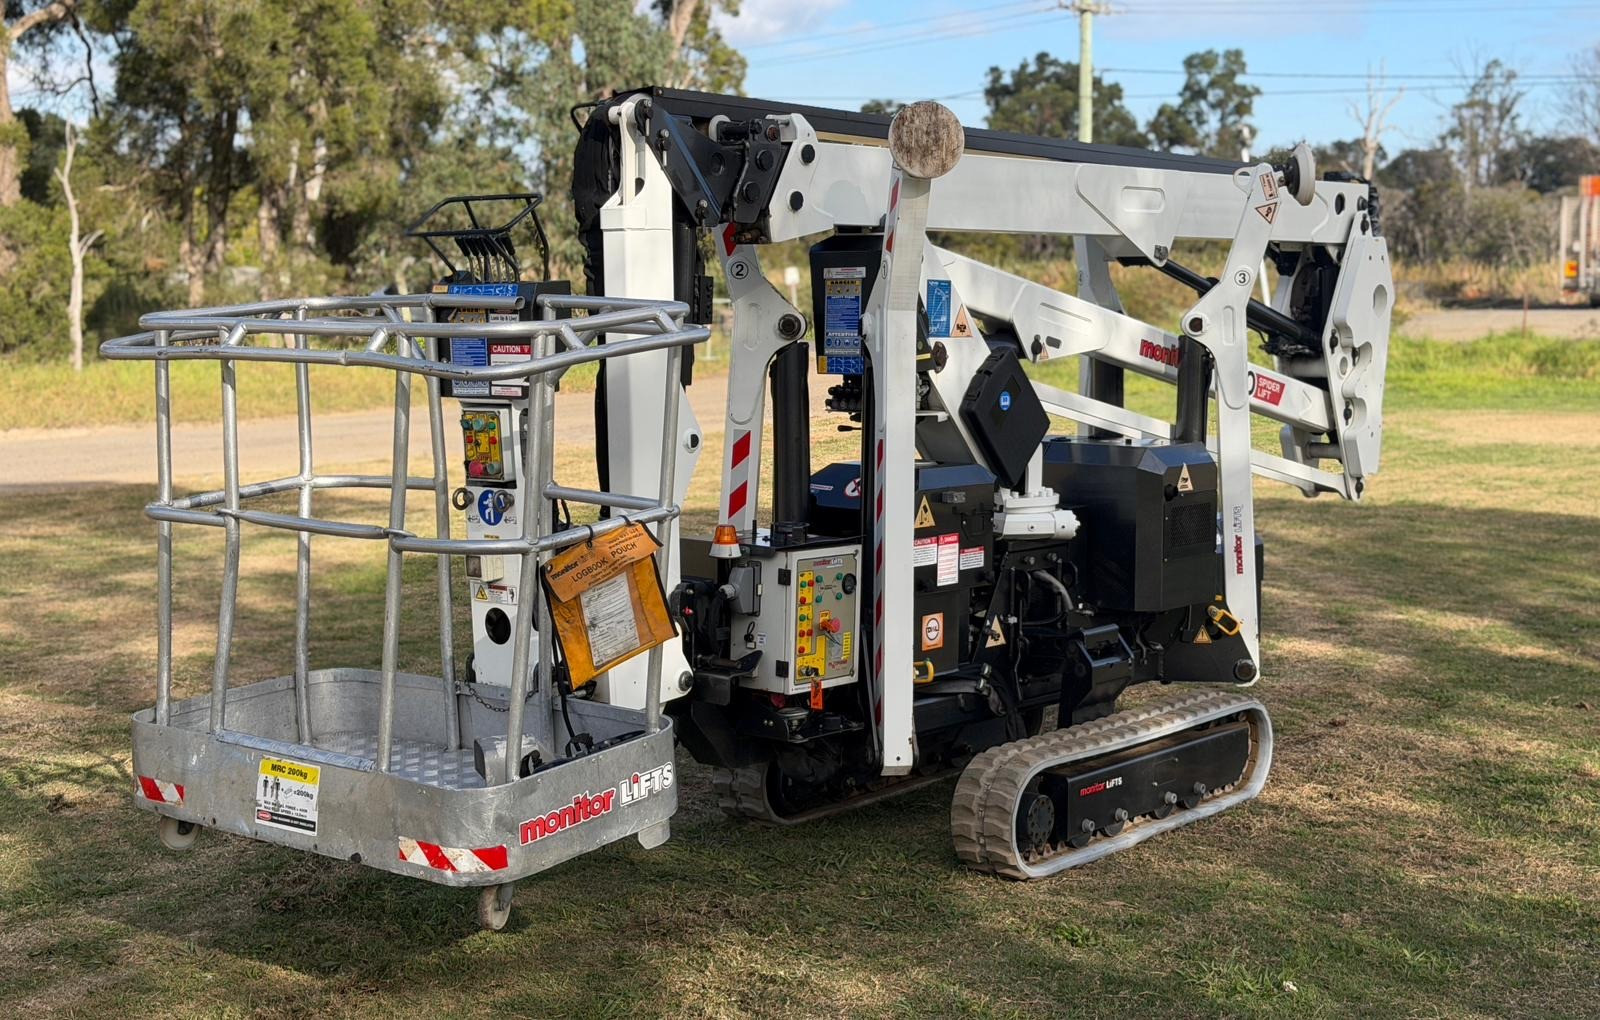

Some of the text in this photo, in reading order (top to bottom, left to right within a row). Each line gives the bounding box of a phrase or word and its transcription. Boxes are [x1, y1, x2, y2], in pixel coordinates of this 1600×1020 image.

[735, 263, 744, 276] 2
[1238, 272, 1246, 284] 3
[492, 345, 521, 353] CAUTION
[1258, 377, 1281, 393] SPIDER
[1257, 387, 1271, 401] LIFT
[571, 557, 609, 583] LOGBOOK
[610, 542, 638, 559] POUCH
[1233, 535, 1244, 574] monitor
[550, 561, 579, 581] monitor
[271, 764, 308, 780] MRC 200kg
[1080, 783, 1105, 797] monitor
[520, 789, 616, 846] monitor
